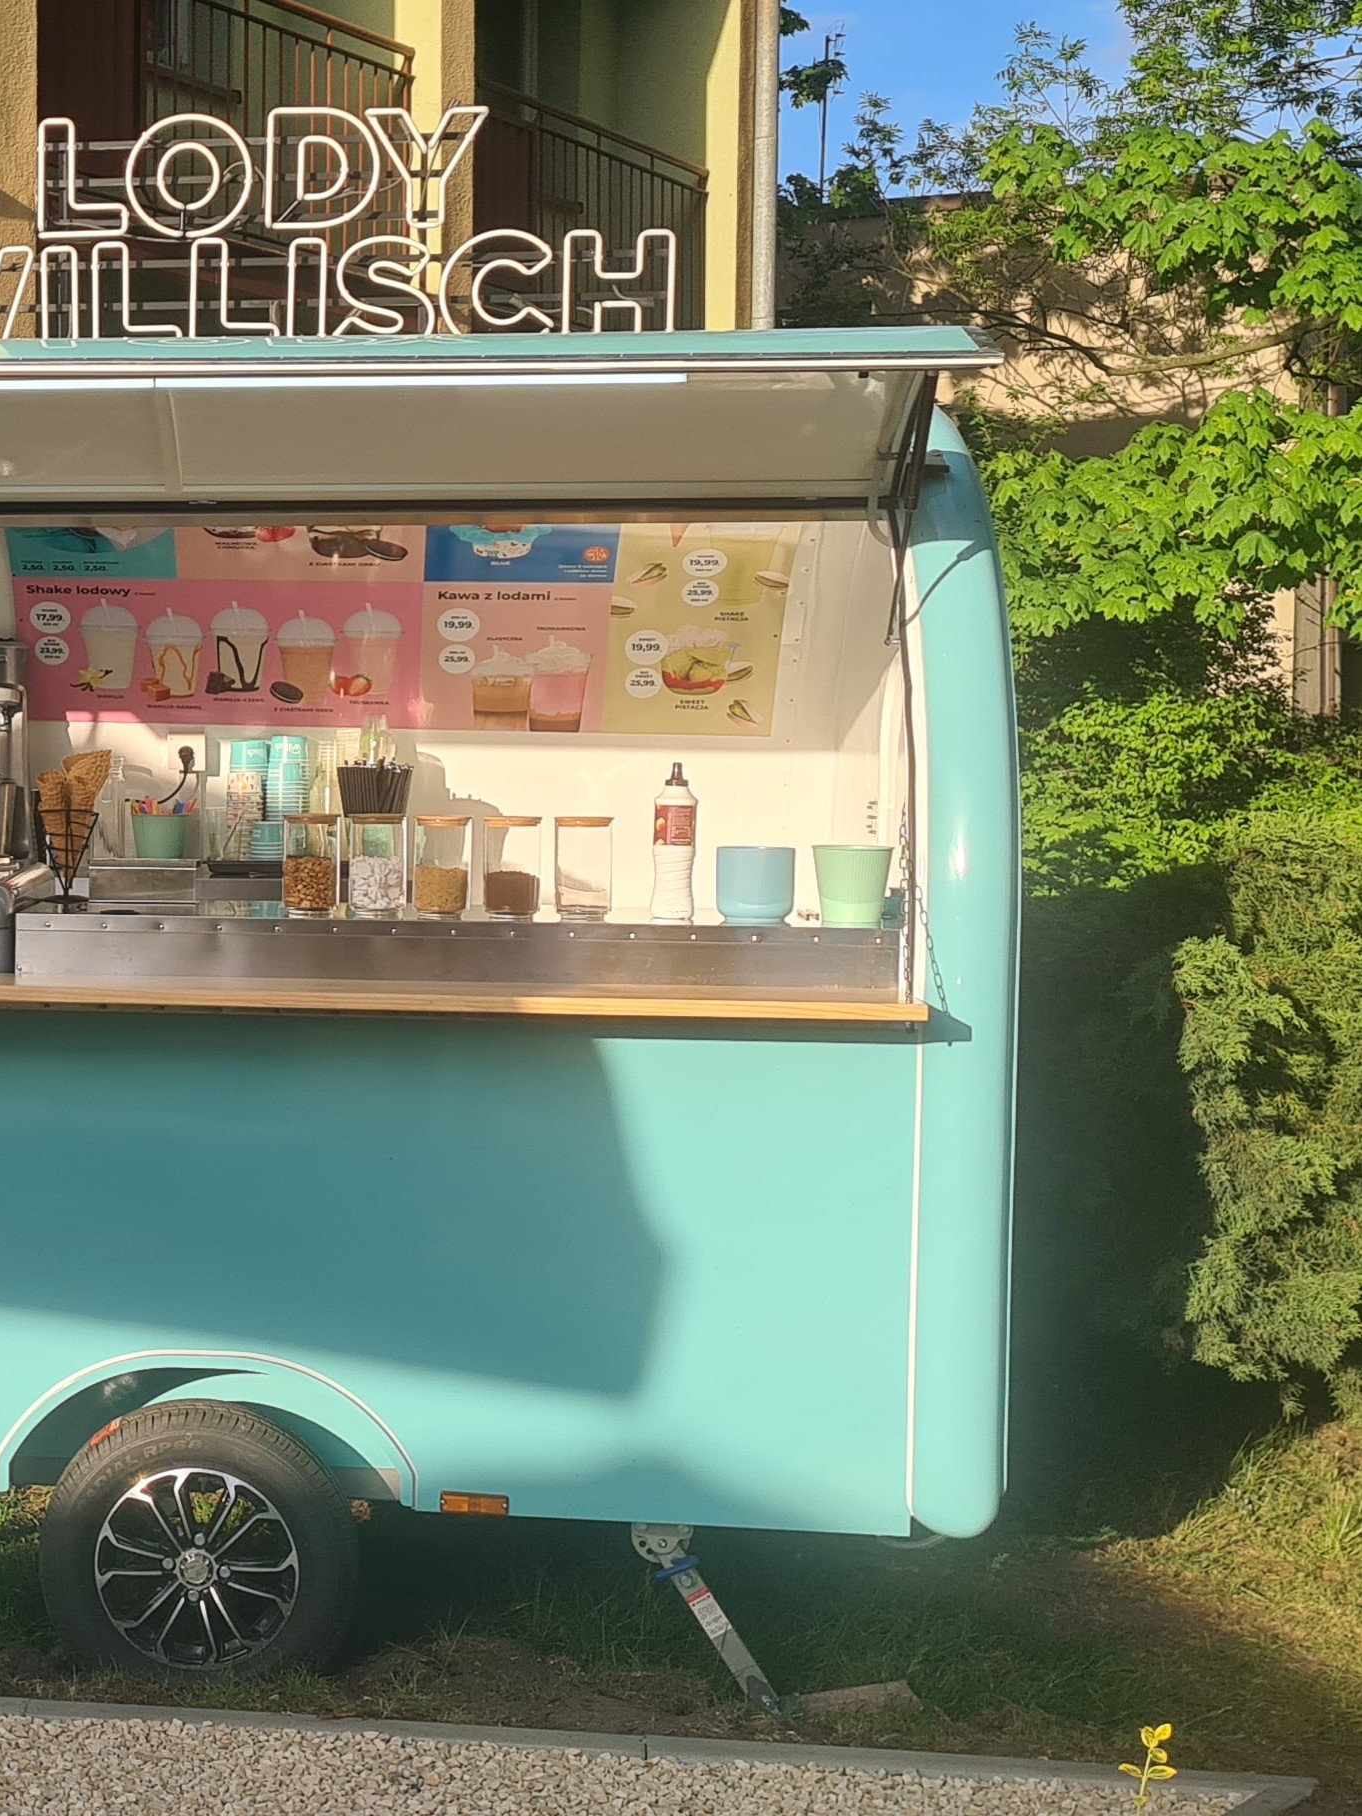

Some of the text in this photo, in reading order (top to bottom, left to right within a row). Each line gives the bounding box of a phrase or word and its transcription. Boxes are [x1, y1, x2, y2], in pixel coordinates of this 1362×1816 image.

[38, 105, 489, 238] LODY
[26, 585, 72, 595] Shake
[76, 585, 131, 598] lodowy
[437, 590, 551, 601] Kawa z lodami
